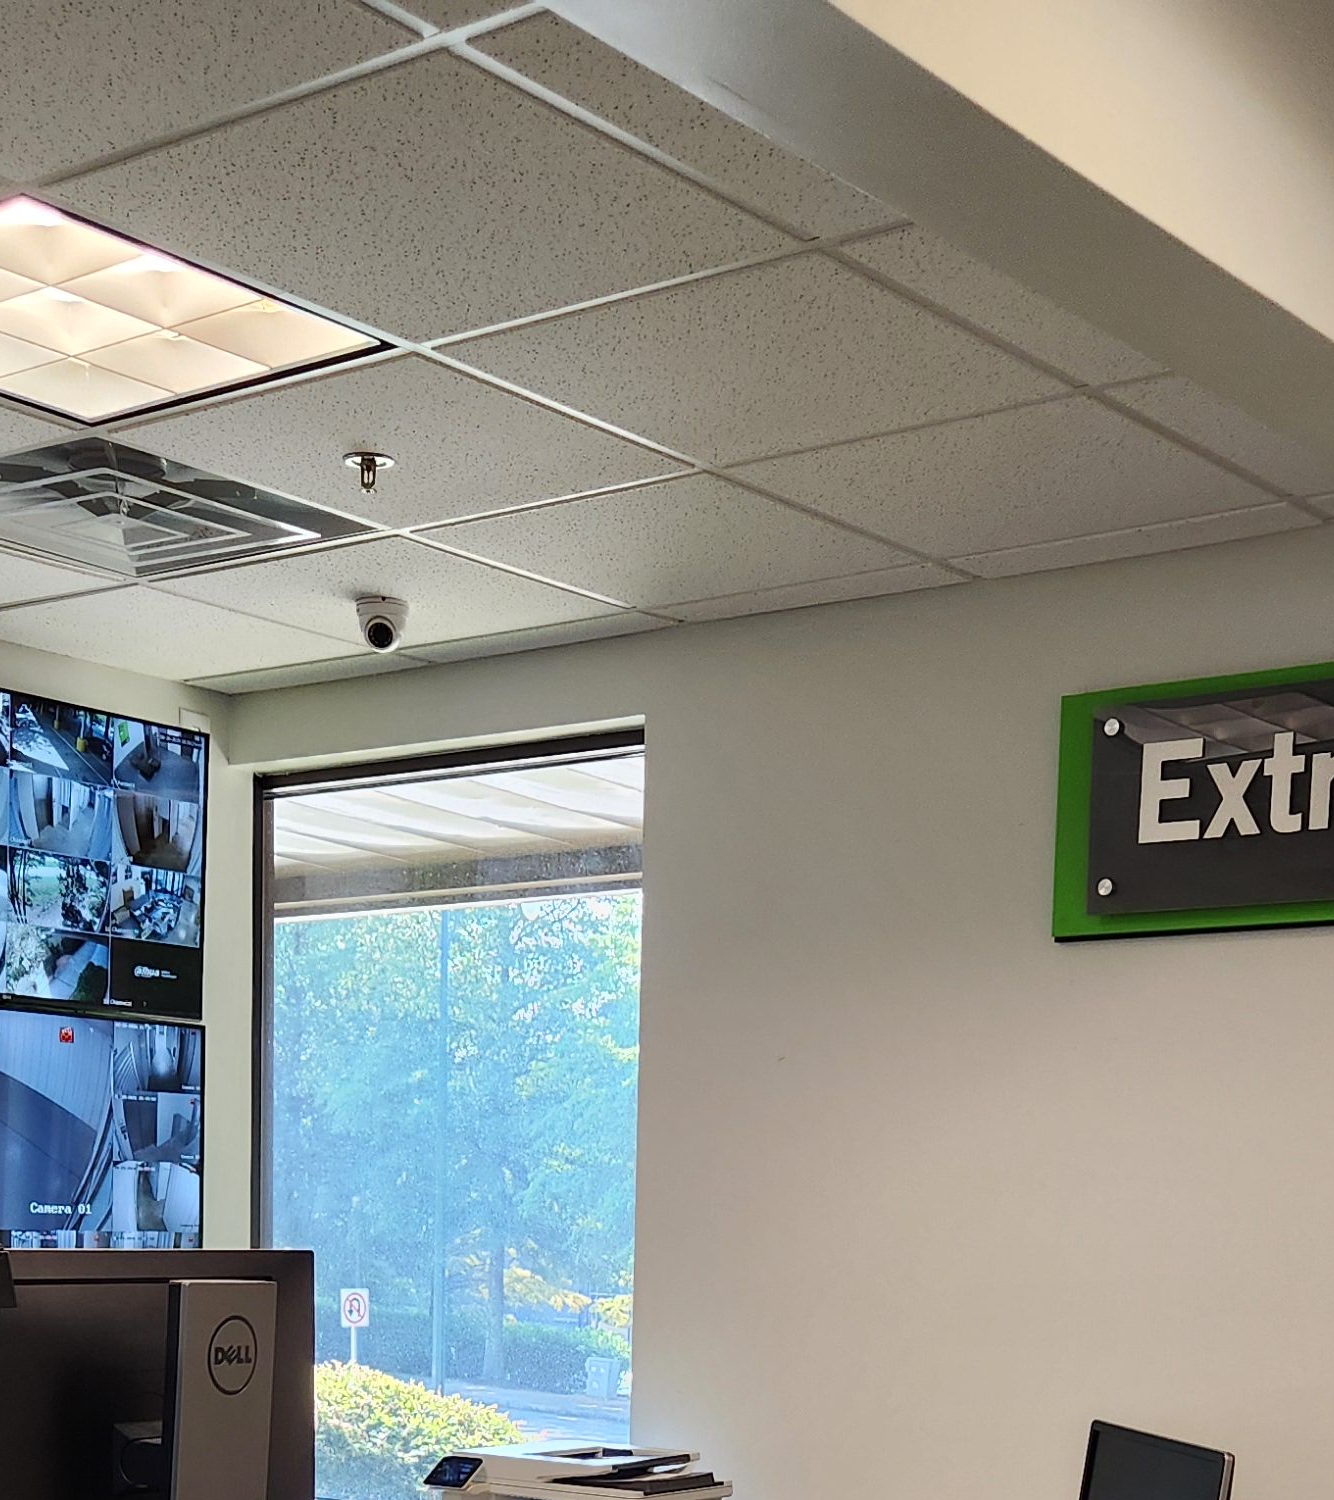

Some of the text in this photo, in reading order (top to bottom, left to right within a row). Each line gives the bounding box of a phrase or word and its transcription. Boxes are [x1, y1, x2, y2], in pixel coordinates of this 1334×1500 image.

[29, 1202, 92, 1215] Camera 01
[214, 1345, 252, 1366] DELL
